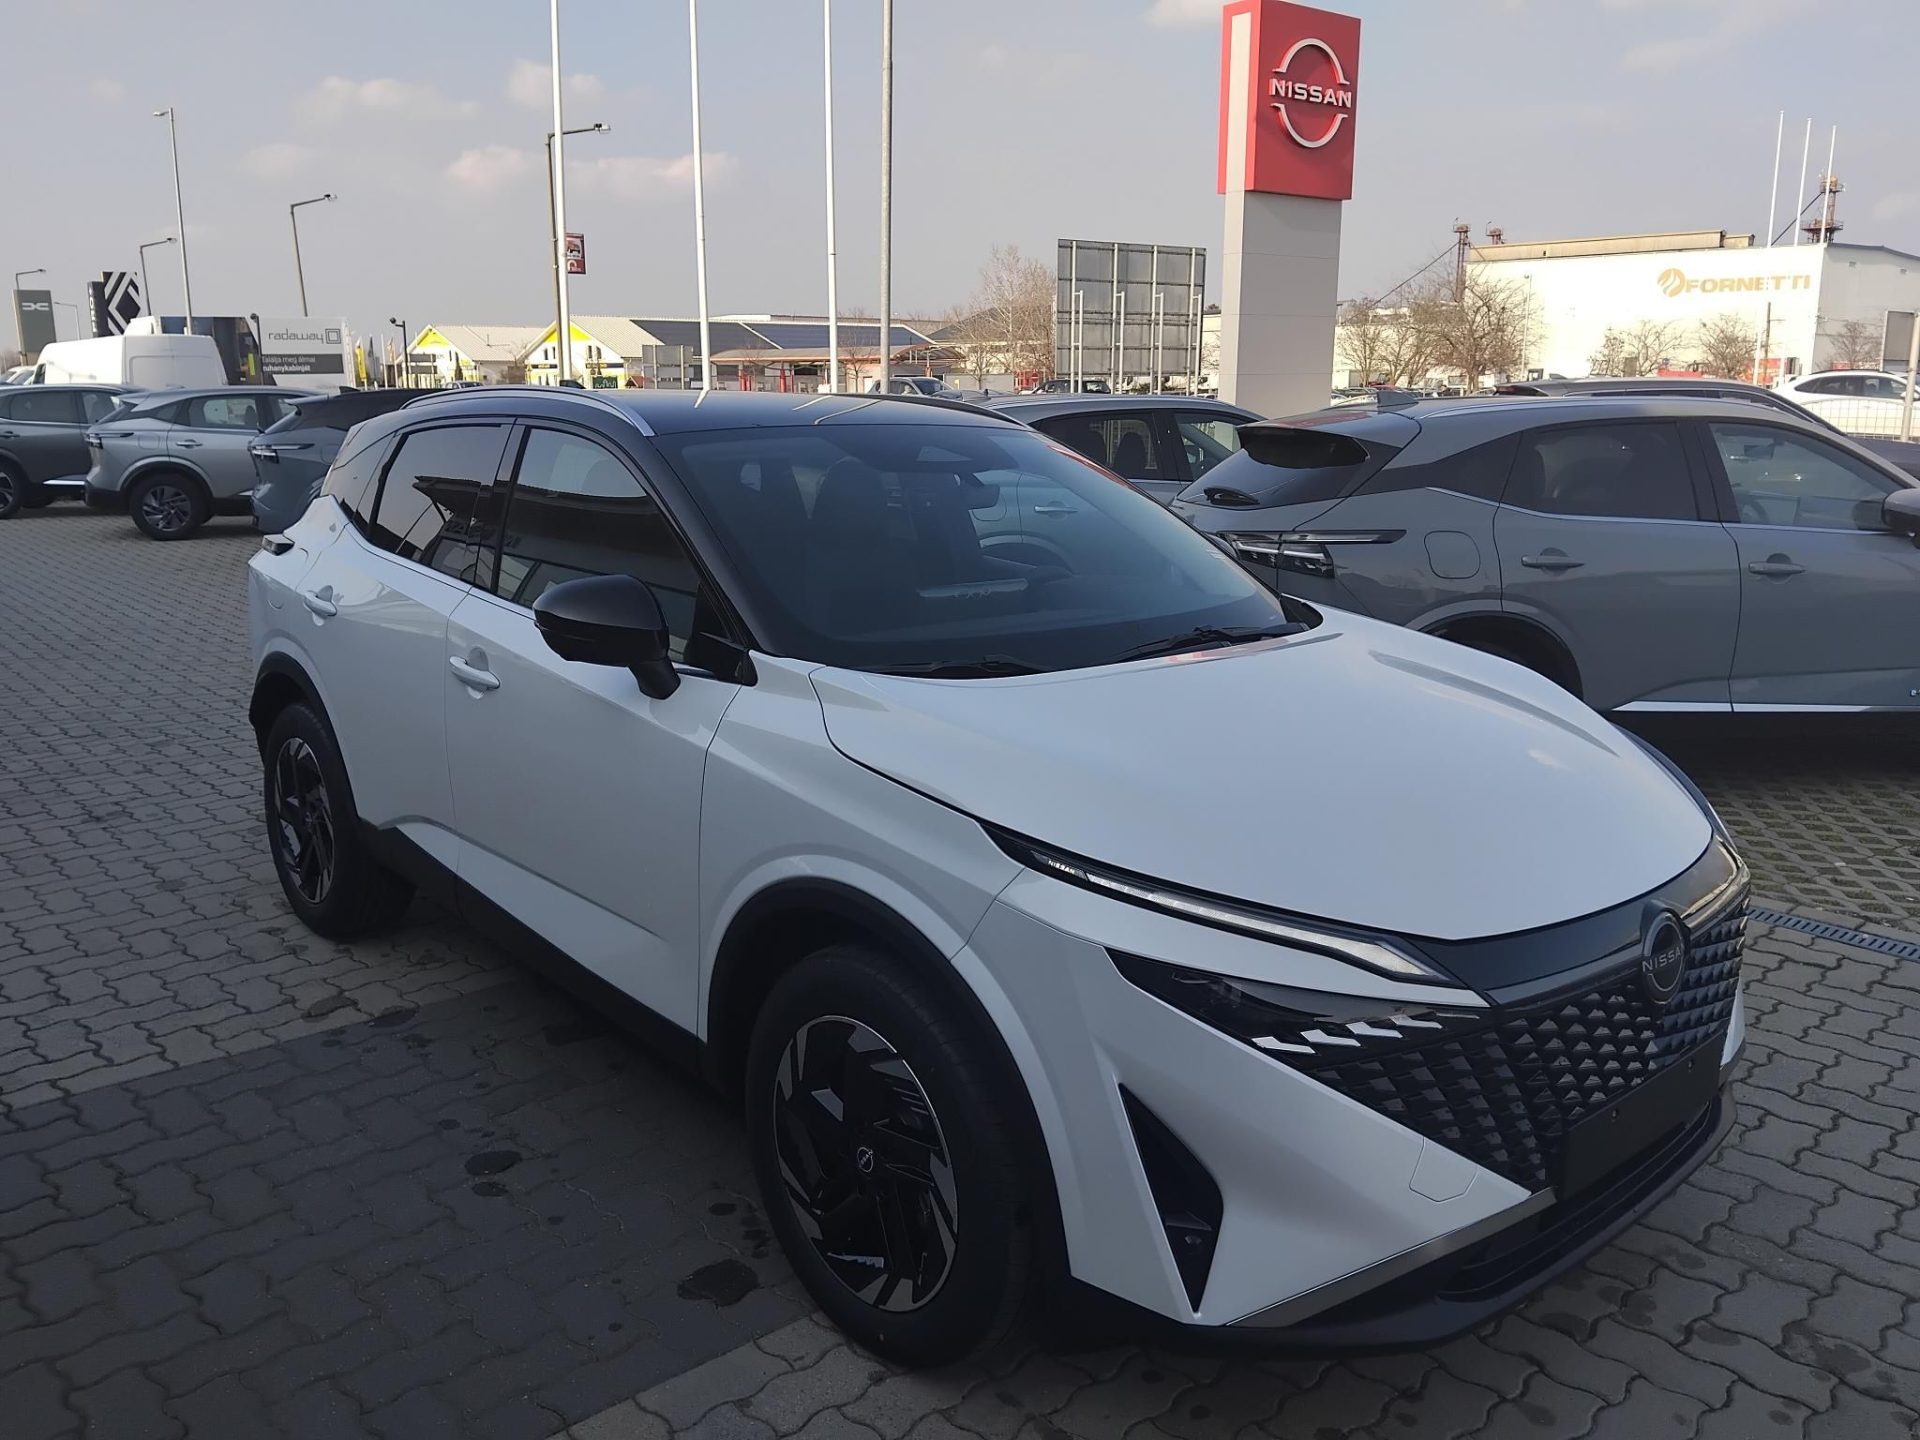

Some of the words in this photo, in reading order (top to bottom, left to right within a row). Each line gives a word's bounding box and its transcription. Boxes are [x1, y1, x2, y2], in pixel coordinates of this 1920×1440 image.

[1269, 78, 1352, 108] NISSAN
[1685, 275, 1811, 293] FORNETTI
[268, 328, 324, 344] radaway
[1048, 860, 1075, 875] NISSAN
[1642, 946, 1685, 972] NISSA
